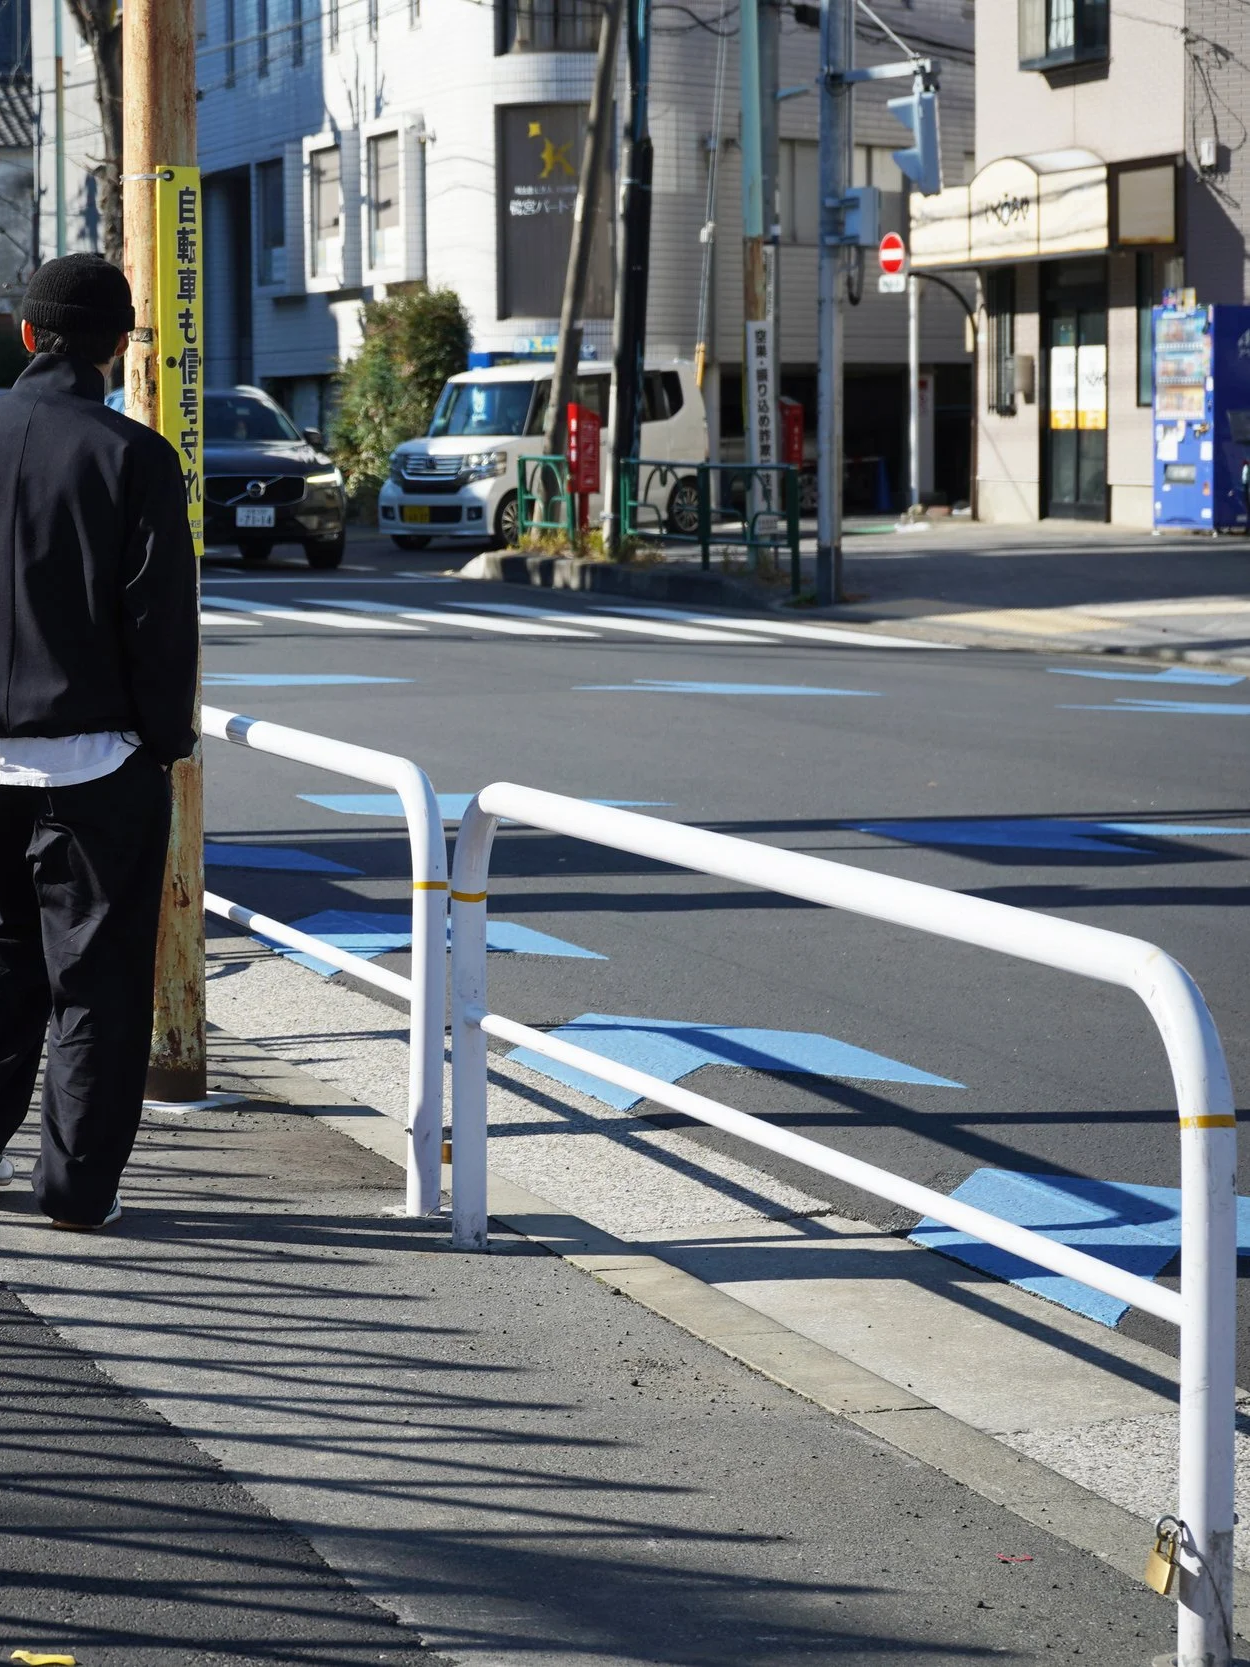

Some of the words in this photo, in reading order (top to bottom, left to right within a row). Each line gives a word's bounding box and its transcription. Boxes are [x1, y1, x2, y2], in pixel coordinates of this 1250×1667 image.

[177, 186, 201, 504] 自転車も信号守れ
